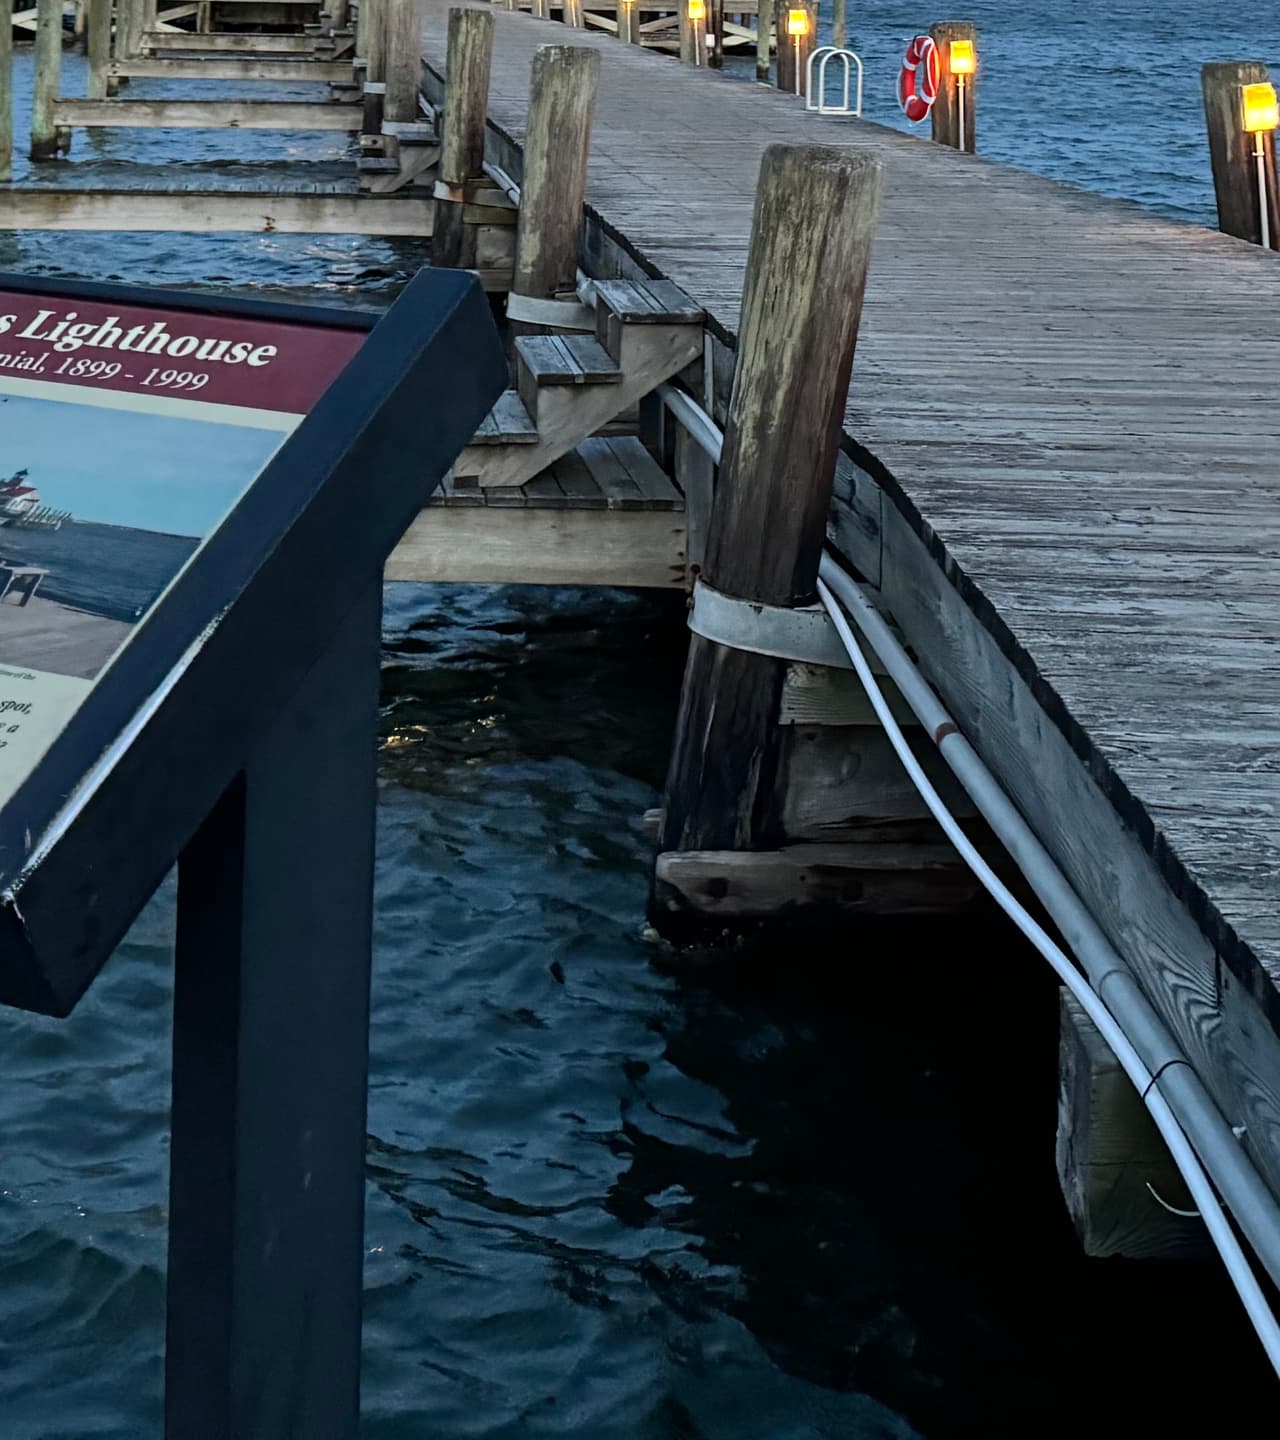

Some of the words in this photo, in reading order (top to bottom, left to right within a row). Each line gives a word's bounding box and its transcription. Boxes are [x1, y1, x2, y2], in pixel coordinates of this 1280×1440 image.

[15, 310, 276, 365] Lighthouse
[54, 358, 121, 378] 1899
[140, 368, 208, 390] 1999
[6, 724, 20, 733] a
